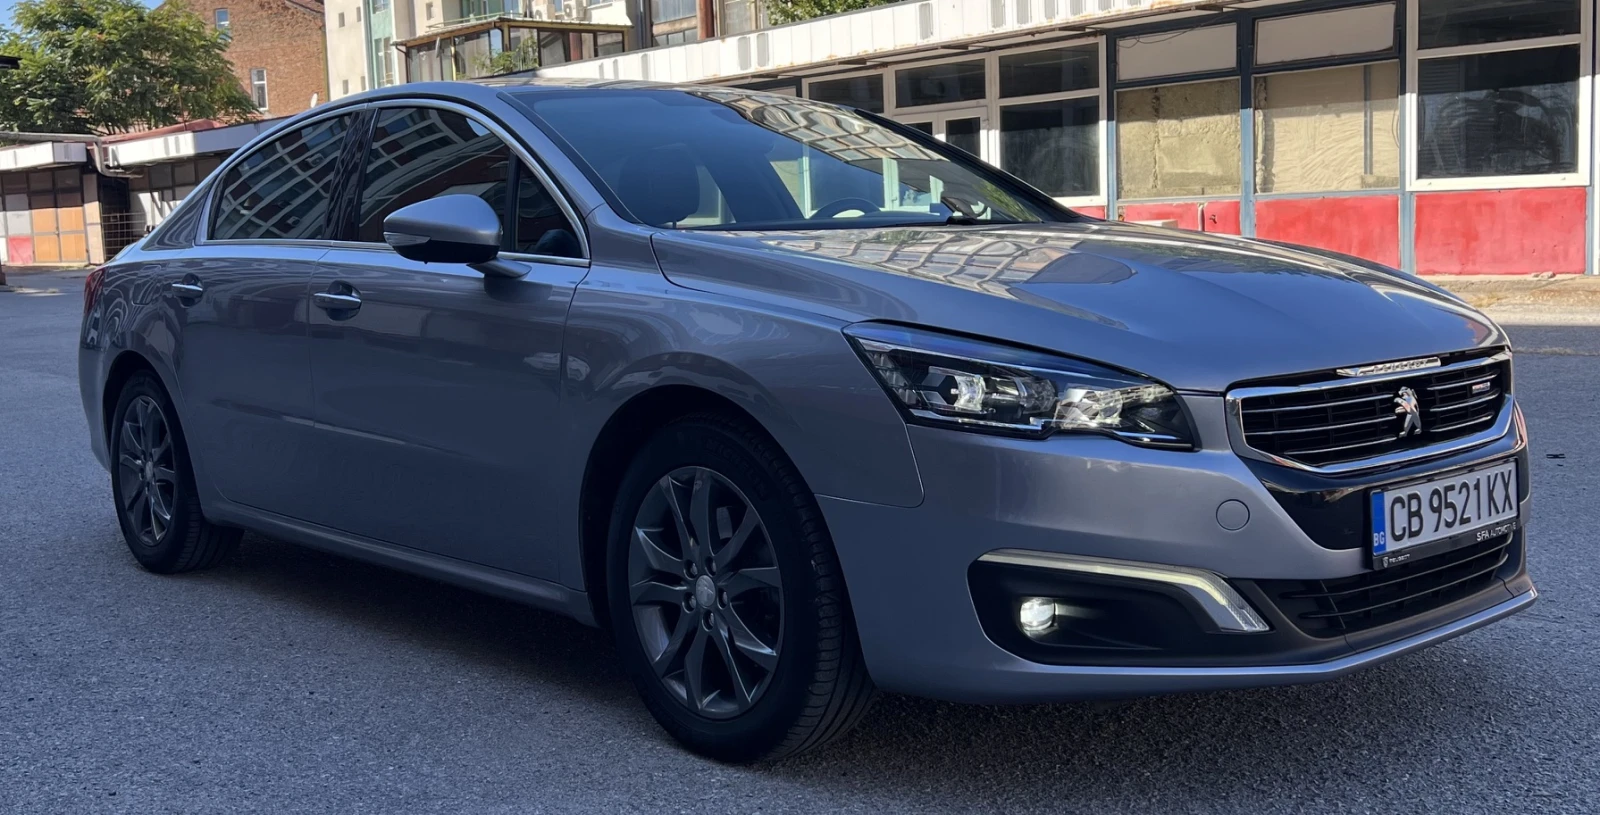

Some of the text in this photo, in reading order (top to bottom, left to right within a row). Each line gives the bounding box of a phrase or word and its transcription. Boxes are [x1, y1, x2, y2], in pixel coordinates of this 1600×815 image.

[1390, 469, 1514, 542] CB 9521 KX
[1373, 532, 1385, 547] BG
[1476, 531, 1490, 541] SFA
